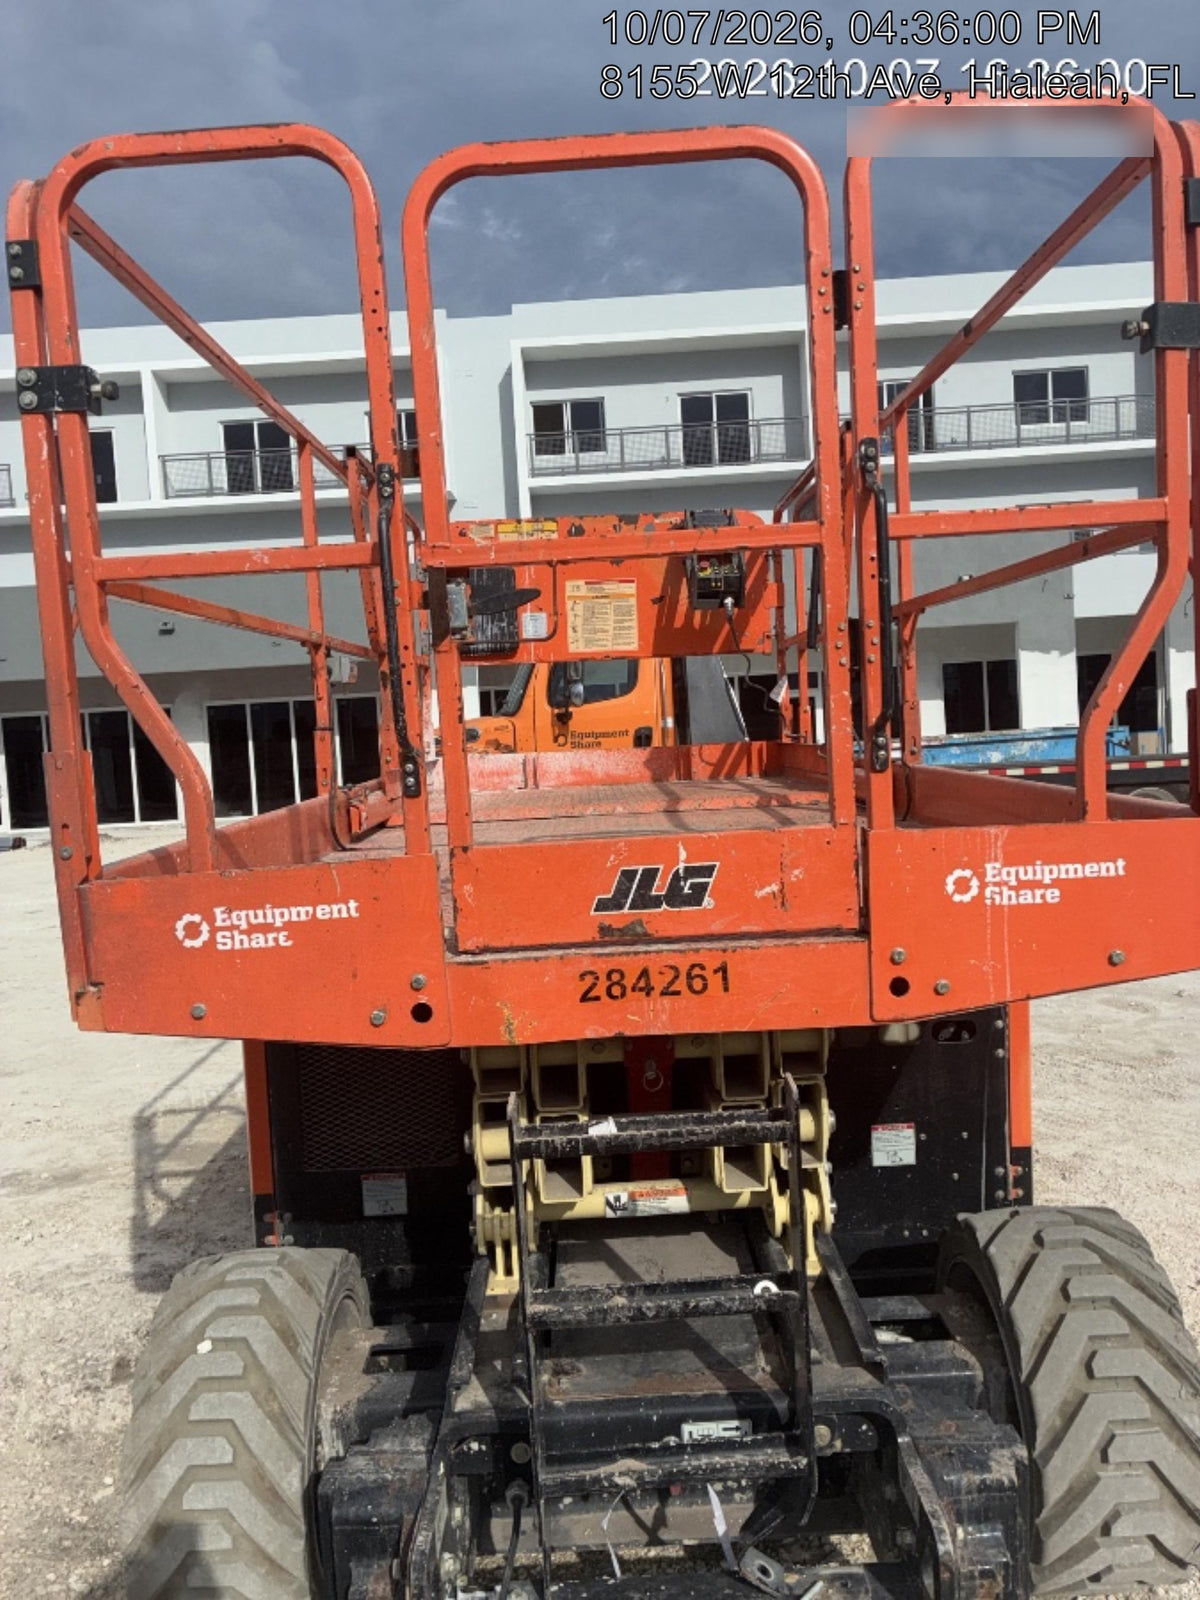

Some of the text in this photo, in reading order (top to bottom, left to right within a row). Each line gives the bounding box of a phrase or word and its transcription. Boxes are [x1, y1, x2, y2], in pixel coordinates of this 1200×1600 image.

[570, 728, 630, 740] Equipment
[570, 740, 602, 749] Share
[983, 858, 1126, 886] Equipment
[590, 862, 720, 915] JLG
[984, 886, 1061, 906] Share
[213, 898, 359, 930] Equipment
[215, 930, 294, 951] Share
[578, 960, 730, 1003] 284261
